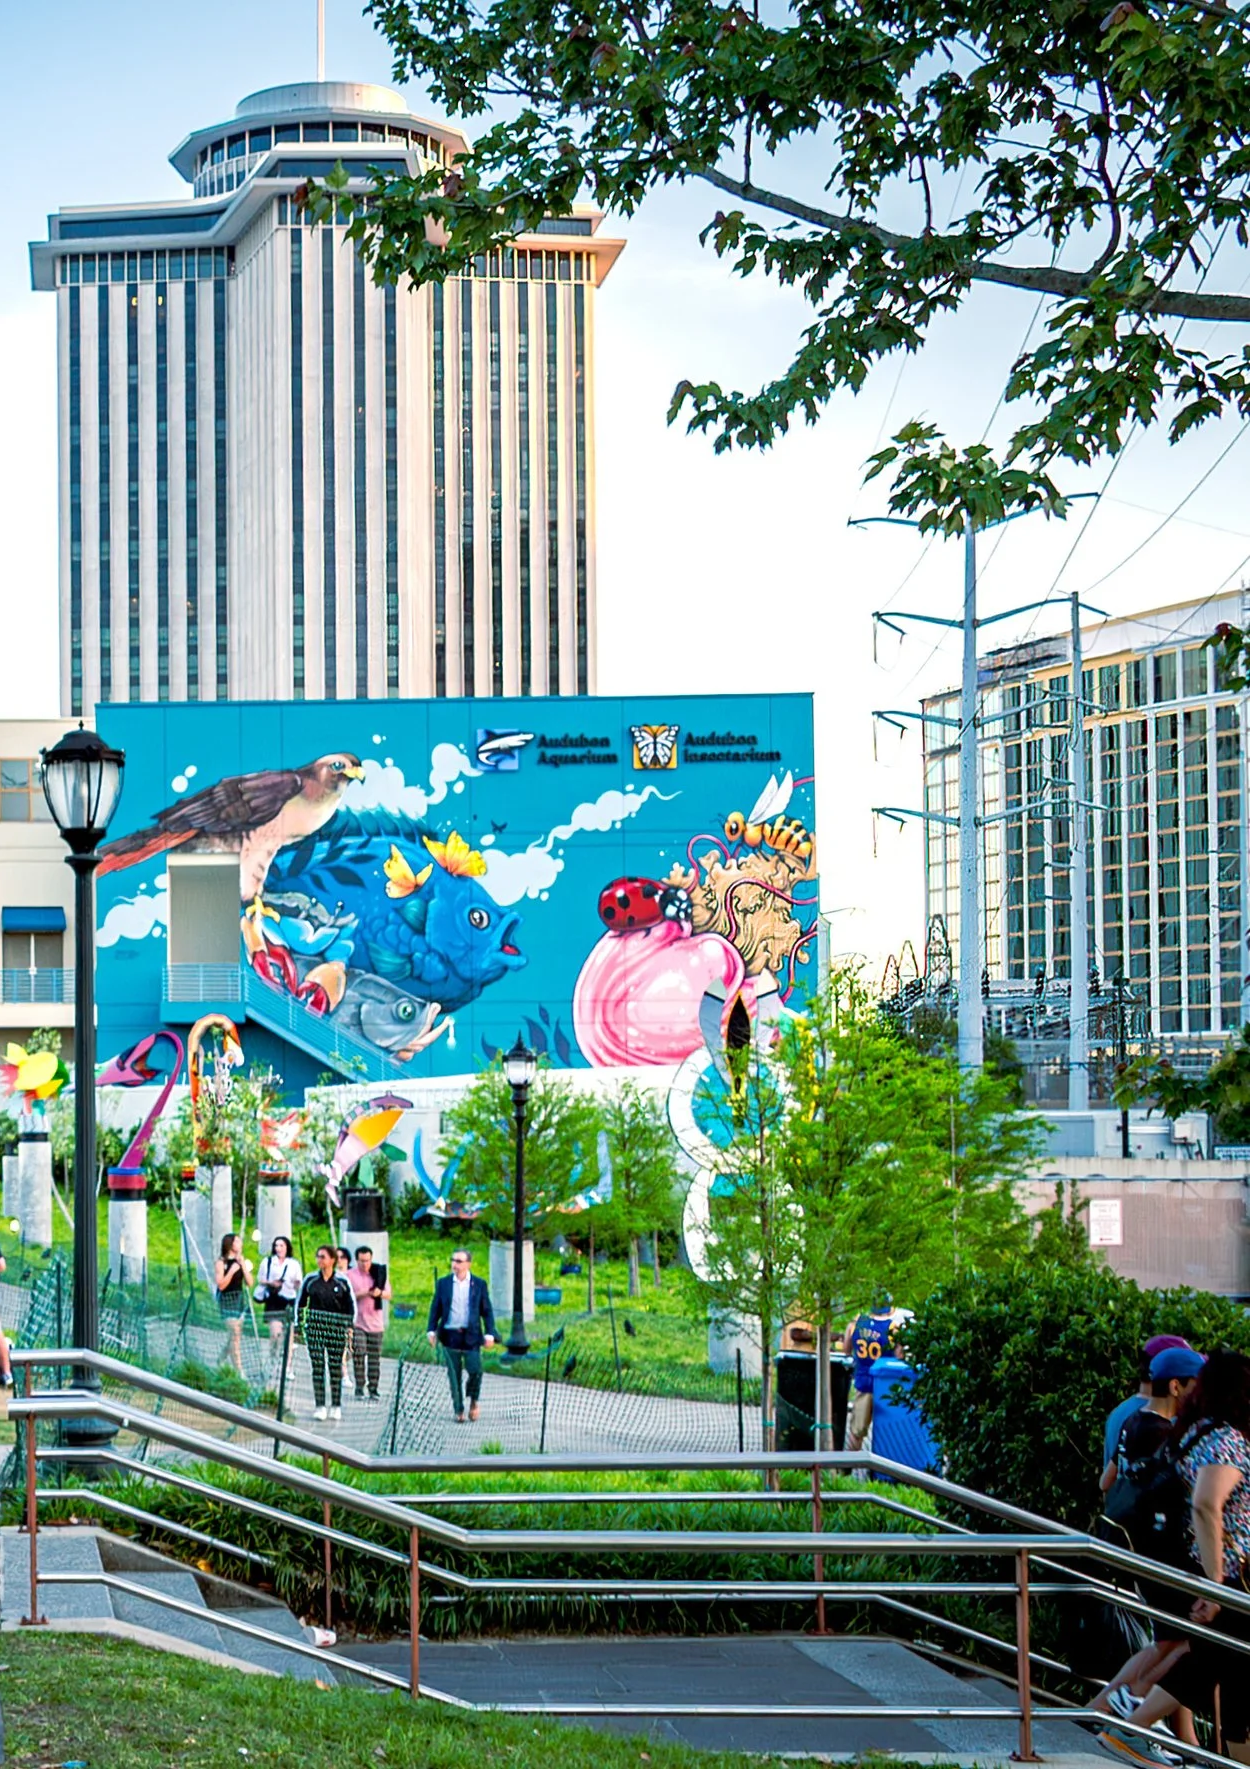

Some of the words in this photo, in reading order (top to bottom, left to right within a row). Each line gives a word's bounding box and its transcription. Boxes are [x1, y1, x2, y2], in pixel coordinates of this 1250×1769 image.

[537, 733, 610, 748] Audubon
[684, 731, 758, 746] Audubon
[537, 749, 618, 767] Aquarium
[684, 747, 781, 763] Insectarium
[856, 1339, 882, 1360] 30
